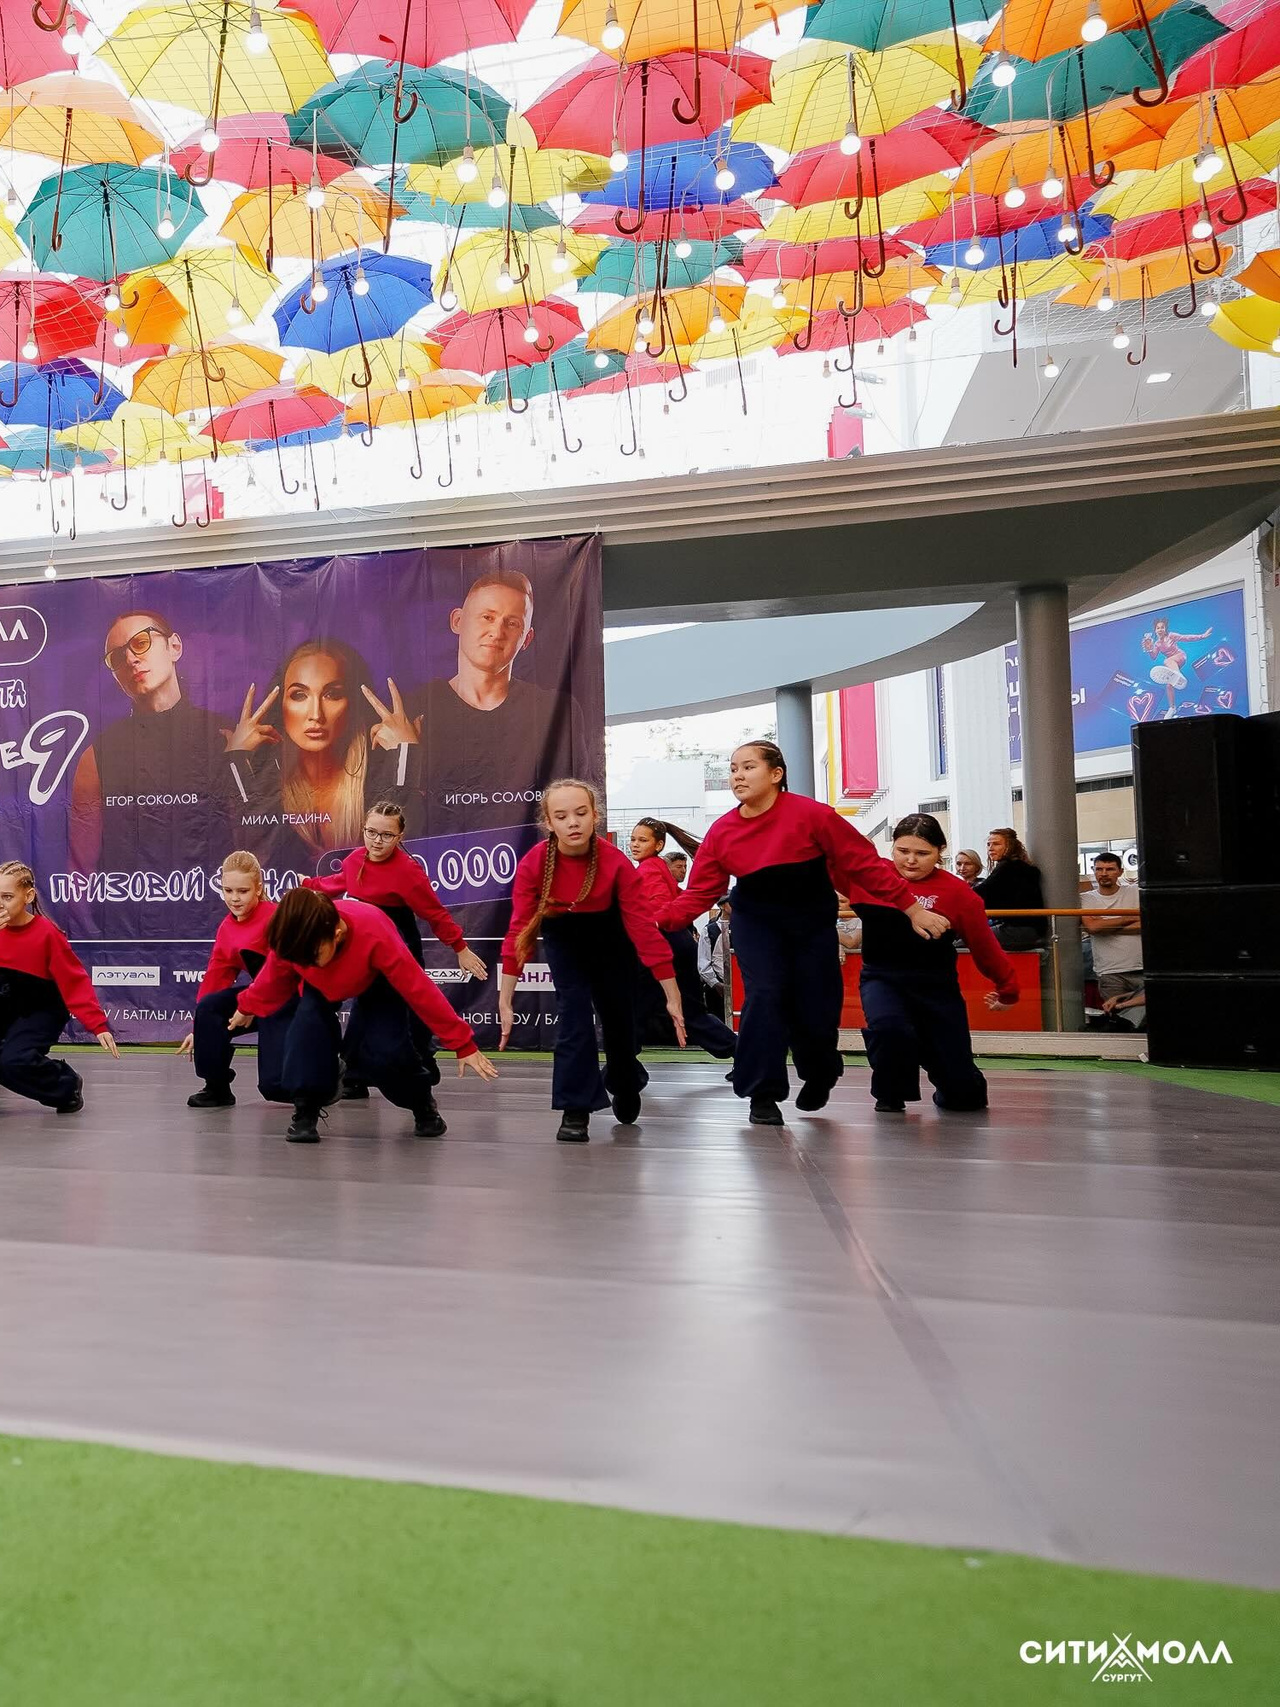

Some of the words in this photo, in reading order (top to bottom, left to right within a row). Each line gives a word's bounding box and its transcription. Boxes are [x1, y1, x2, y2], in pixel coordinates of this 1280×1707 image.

[106, 796, 134, 807] ЕГОР
[136, 793, 198, 805] СОКОЛОВ
[445, 793, 488, 805] ИГОРЬ
[492, 790, 545, 803] СОЛОВ
[241, 814, 279, 826] МИЛА
[282, 812, 332, 825] РЕДИНА
[49, 866, 204, 903] ПРИЗОВОЙ
[425, 970, 461, 978] РСАЖ
